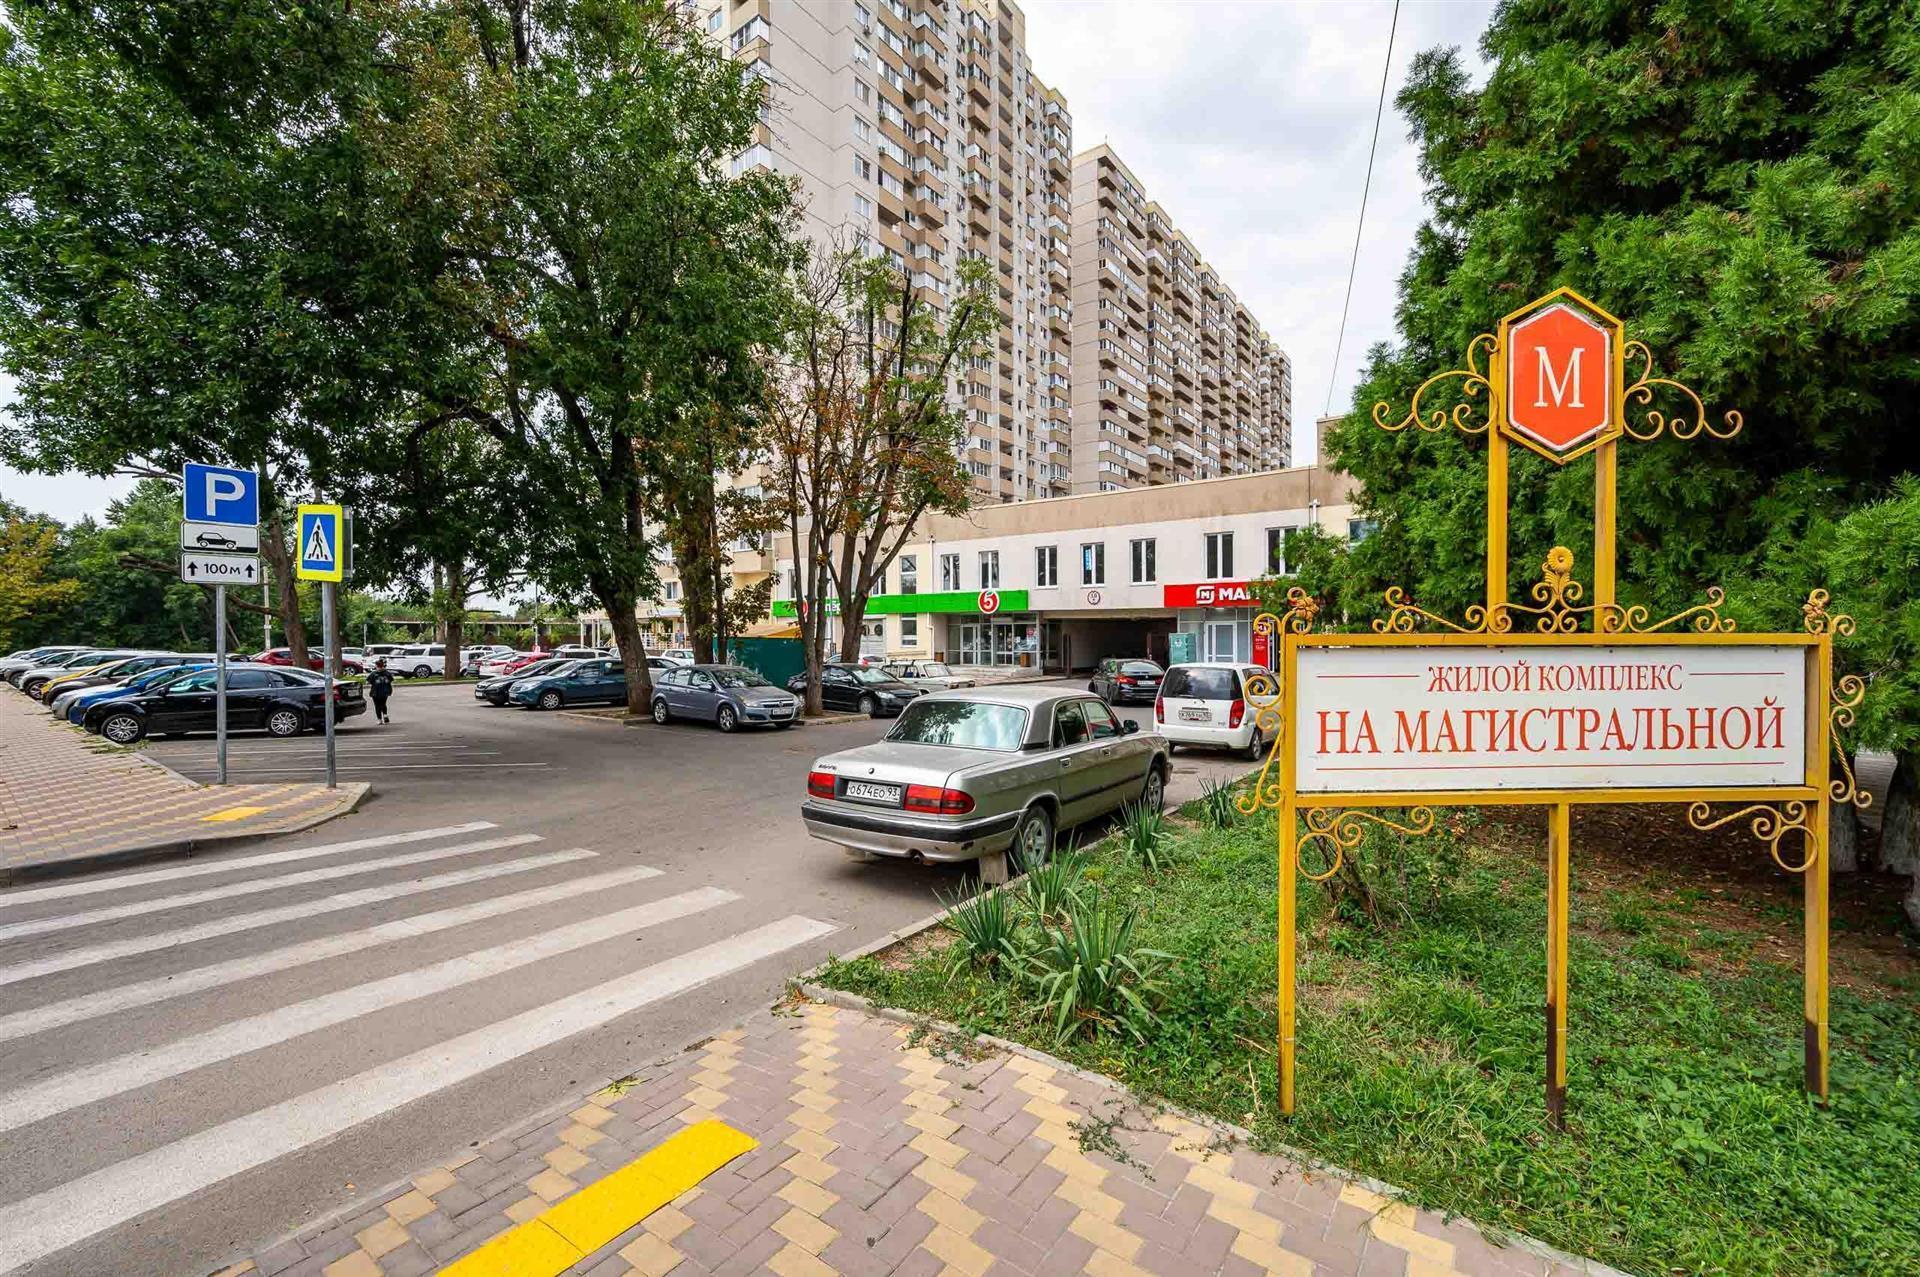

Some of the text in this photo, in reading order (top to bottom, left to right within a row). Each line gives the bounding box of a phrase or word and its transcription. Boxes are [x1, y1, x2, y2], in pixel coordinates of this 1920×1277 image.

[1533, 346, 1585, 408] М
[205, 472, 246, 516] P
[983, 591, 994, 609] 5
[1427, 659, 1684, 692] ЖИЛОЙ КОМПЛЕКС
[1316, 695, 1785, 754] НА МАГИСТРАЛЬНОЙ
